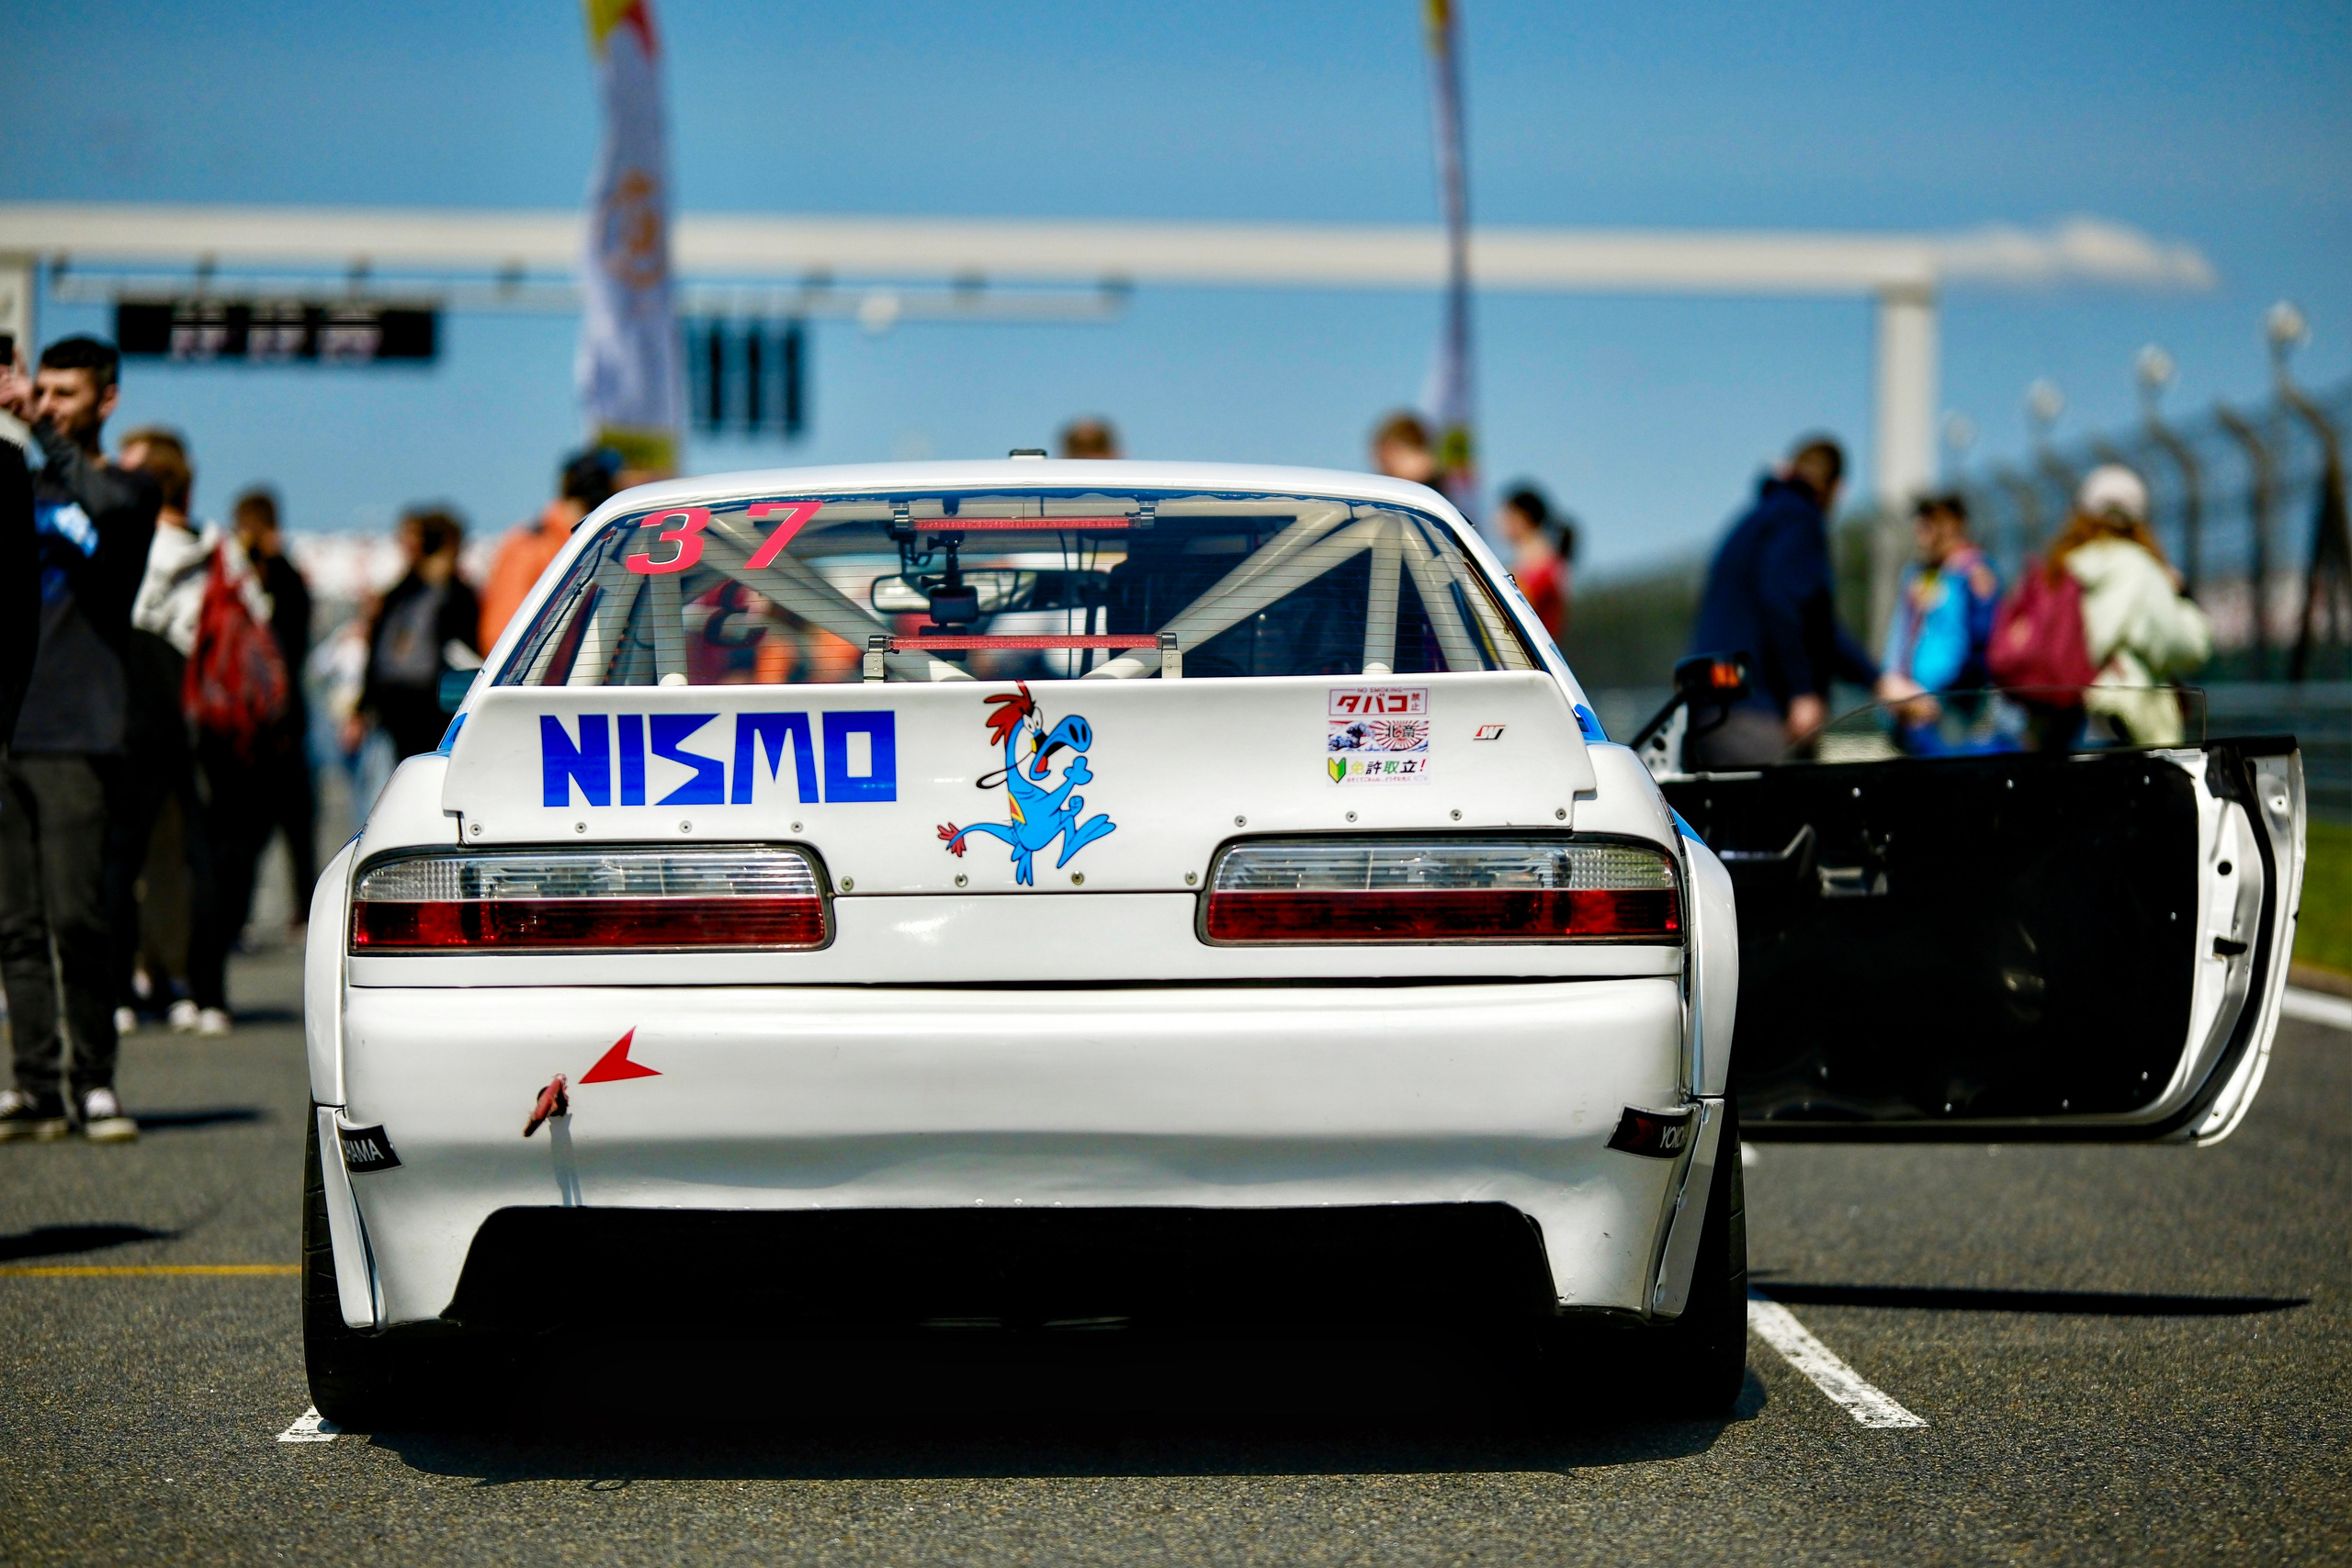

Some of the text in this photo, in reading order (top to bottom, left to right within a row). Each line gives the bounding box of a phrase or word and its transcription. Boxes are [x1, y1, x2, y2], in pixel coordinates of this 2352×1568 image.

[626, 502, 823, 574] 37
[1337, 694, 1408, 713] タバコ
[539, 710, 897, 807] NISMO
